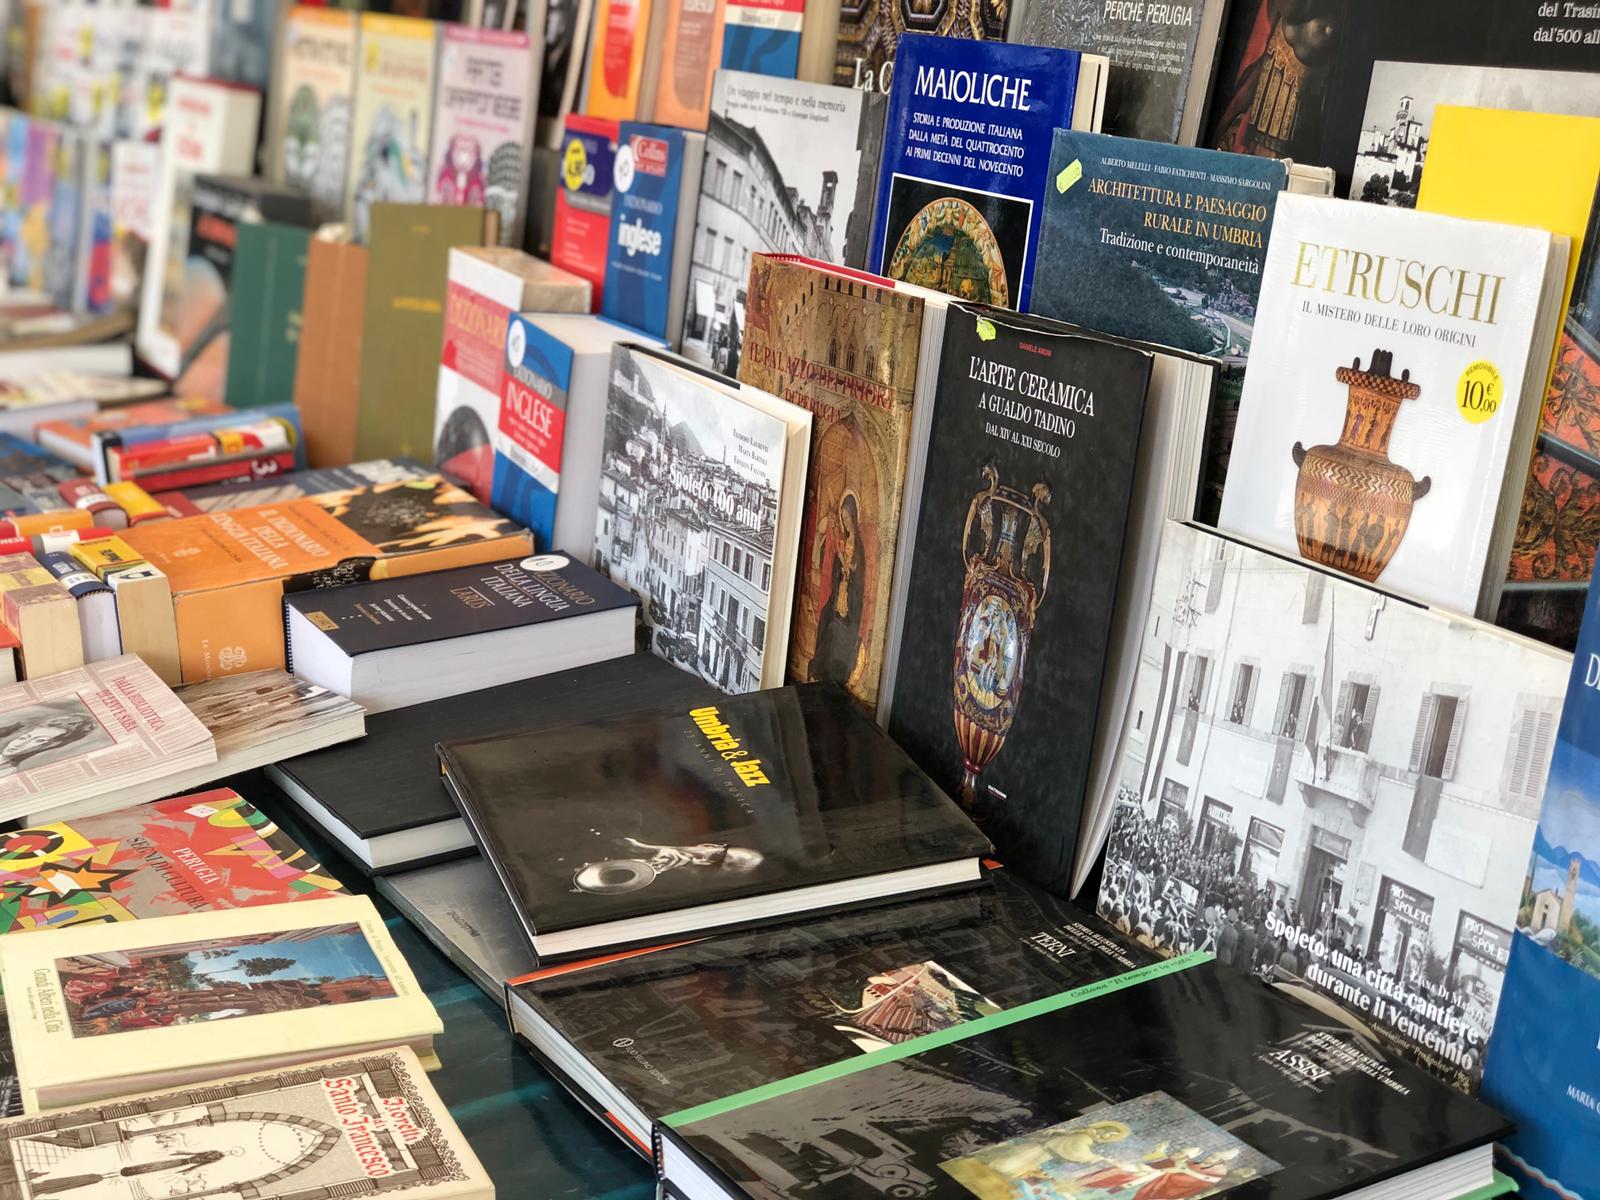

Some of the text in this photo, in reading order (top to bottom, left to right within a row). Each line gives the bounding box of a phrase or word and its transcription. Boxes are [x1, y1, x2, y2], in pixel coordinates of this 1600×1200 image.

[1146, 4, 1192, 26] PERUGIA
[1537, 2, 1559, 17] del
[852, 57, 874, 92] La
[914, 65, 1032, 111] MAIOLICHE
[738, 89, 759, 101] viaggio
[762, 91, 772, 101] nel
[774, 93, 793, 105] tempo
[801, 96, 815, 108] nella
[818, 99, 846, 112] memoria
[908, 129, 1024, 159] DALLA METÀ DEL QUATTROCENTO
[913, 112, 1022, 140] STORIA E PRODUZIONE ITALIANA
[905, 147, 1023, 177] AI PRIMI DECENNI DEL NOVECENTO
[1100, 157, 1271, 190] ALBERTO MELELLI FABIO FATICHENTI MASSIMO SARGOLINI
[1088, 177, 1267, 222] ARCHITETTURA E PAESAGGIO
[618, 214, 661, 256] inglese
[1144, 211, 1262, 249] RURALE IN UMBRIA
[1100, 228, 1259, 274] Tradizione e contemporaneità
[1290, 241, 1506, 325] ETRUSCHI
[1302, 300, 1477, 348] IL MISTERO DELLE LORO ORIGINI
[750, 342, 761, 364] IL
[765, 347, 817, 382] PALAZZO
[1465, 362, 1499, 381] REMOVIBILE
[968, 356, 1095, 416] L'ARTE CERAMICA
[506, 381, 554, 438] INGLESE
[979, 392, 1076, 439] A GUALDO TADINO
[985, 422, 1061, 458] DAL XIV AL XXI SECOLO
[669, 463, 709, 504] Spoleto
[736, 502, 761, 532] anni
[238, 534, 289, 570] ITALIANA
[251, 525, 289, 549] DELLA
[265, 515, 331, 557] DIZIONARIO
[480, 576, 533, 608] ITALIANA
[494, 564, 571, 612] DELLA LINGUA
[1584, 652, 1600, 691] D
[128, 693, 166, 731] BIBLIOTECA
[689, 706, 771, 787] Umbria & Jazz
[724, 781, 754, 814] MUSICA
[126, 836, 160, 864] SEGNI
[159, 869, 208, 909] CULTURA
[172, 847, 219, 885] PERUGIA
[1030, 932, 1077, 958] TERNI
[1063, 925, 1083, 939] DELLE
[1072, 922, 1094, 936] STORIA
[1092, 931, 1128, 955] ILLUSTRATA
[1264, 910, 1330, 961] Spoleto:
[1331, 950, 1362, 979] una
[1465, 917, 1484, 935] PRO
[1070, 982, 1108, 999] Collana
[1307, 963, 1370, 1012] durante
[1373, 996, 1387, 1020] il
[1387, 1004, 1473, 1071] Ventennio
[1269, 1048, 1331, 1081] ASSISI
[1309, 1036, 1335, 1055] DELLE
[1317, 1031, 1346, 1051] STORIA
[1344, 1046, 1394, 1077] ILLUSTRATA
[1567, 1084, 1595, 1110] MARIA
[324, 1078, 389, 1177] Santo Francesco
[372, 1118, 386, 1129] di
[383, 1097, 421, 1143] Fioretti
